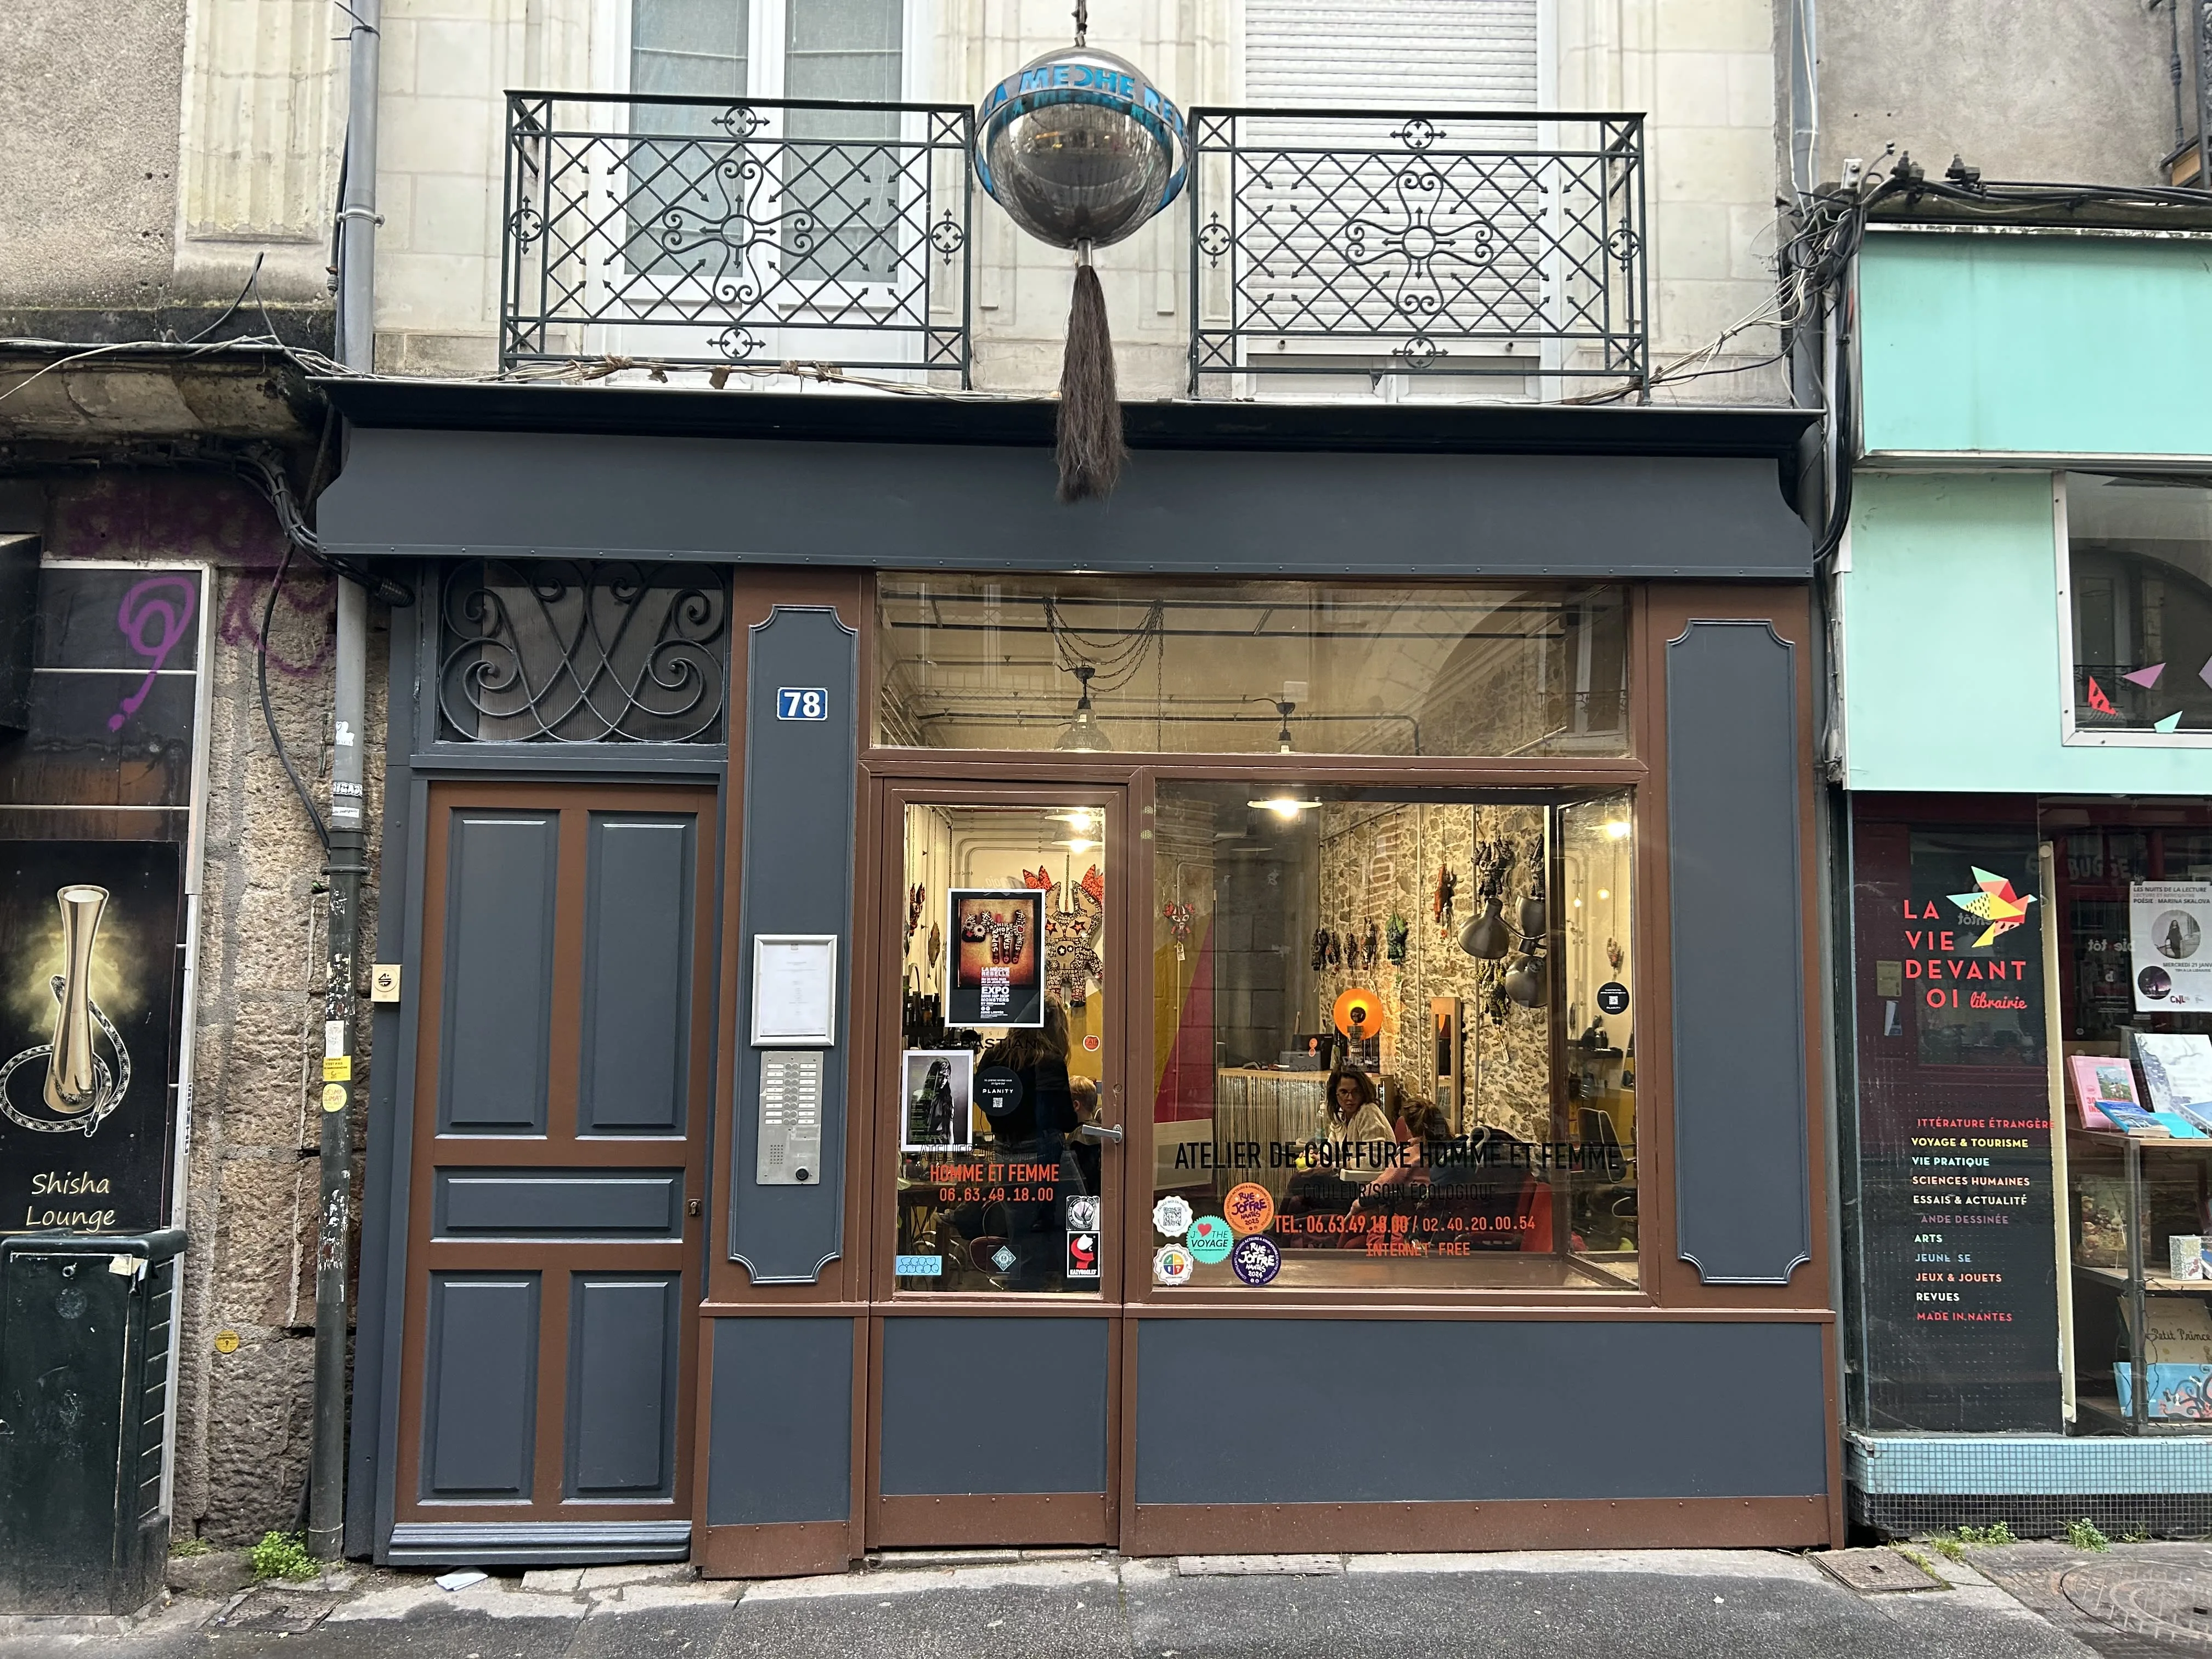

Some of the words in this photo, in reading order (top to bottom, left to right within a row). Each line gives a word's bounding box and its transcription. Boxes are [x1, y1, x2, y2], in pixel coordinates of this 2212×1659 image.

[784, 691, 821, 718] 78
[1903, 899, 1940, 919] LA
[1905, 930, 1955, 951] VIE
[1905, 960, 2027, 980] DEVANT
[981, 986, 1010, 994] EXPO
[1970, 991, 2028, 1009] librairie
[2170, 995, 2186, 1005] CNL
[1988, 1116, 2055, 1129] ÉTRANGÈRE
[1911, 1137, 1956, 1147] VOYAGE
[1960, 1138, 1968, 1147] &
[1971, 1138, 2029, 1148] TOURISME
[1174, 1142, 1262, 1170] ATELIER
[1270, 1142, 1296, 1169] DE
[1305, 1141, 1412, 1169] COIFFURE
[1420, 1141, 1502, 1169] HOMME
[1510, 1142, 1537, 1170] ET
[1542, 1142, 1621, 1170] FEMME
[1911, 1156, 1931, 1166] VIE
[1934, 1157, 1990, 1167] PRATIQUE
[930, 1164, 984, 1182] HOMME
[988, 1164, 1005, 1182] ET
[1008, 1164, 1060, 1182] FEMME
[31, 1171, 110, 1195] Shisha
[1912, 1176, 1968, 1186] SCIENCES
[1971, 1177, 2030, 1186] HUMAINES
[939, 1187, 1054, 1201] 06.63.49.18.00
[1238, 1192, 1255, 1200] RUE
[1410, 1180, 1497, 1201] ÉCOLOGIQUE
[1913, 1195, 1951, 1204] ESSAIS
[1954, 1195, 1962, 1205] &
[1965, 1193, 2028, 1205] ACTUALITÉ
[1231, 1198, 1267, 1215] JOFFRE
[26, 1205, 116, 1234] Lounge
[1240, 1210, 1261, 1220] NANTES
[1955, 1213, 2009, 1224] DESSINÉE
[1244, 1217, 1260, 1226] 2025
[1273, 1215, 1302, 1234] TEL:
[1306, 1215, 1409, 1234] 06.63.49.18.00
[1422, 1216, 1536, 1232] 02.40.20.00.54
[1211, 1230, 1229, 1239] THE
[1914, 1234, 1943, 1243] ARTS
[1191, 1239, 1229, 1248] VOYAGE
[1250, 1242, 1266, 1254] RUE
[1365, 1242, 1429, 1257] INTERNET
[1438, 1242, 1471, 1256] FREE
[1238, 1250, 1276, 1267] JOFFRE
[1915, 1253, 1972, 1262] JEUNESE
[1245, 1263, 1266, 1273] NANTES
[1248, 1270, 1263, 1279] 2024
[1915, 1273, 1944, 1282] JEUX
[1947, 1273, 1955, 1282] &
[1959, 1273, 2002, 1283] JOUETS
[1916, 1293, 1960, 1302] REVUES
[1917, 1312, 1948, 1321] MADE
[1952, 1312, 1964, 1322] IN
[1967, 1312, 2013, 1322] NANTES
[2151, 1328, 2176, 1340] Petit
[2176, 1328, 2211, 1341] Prince
